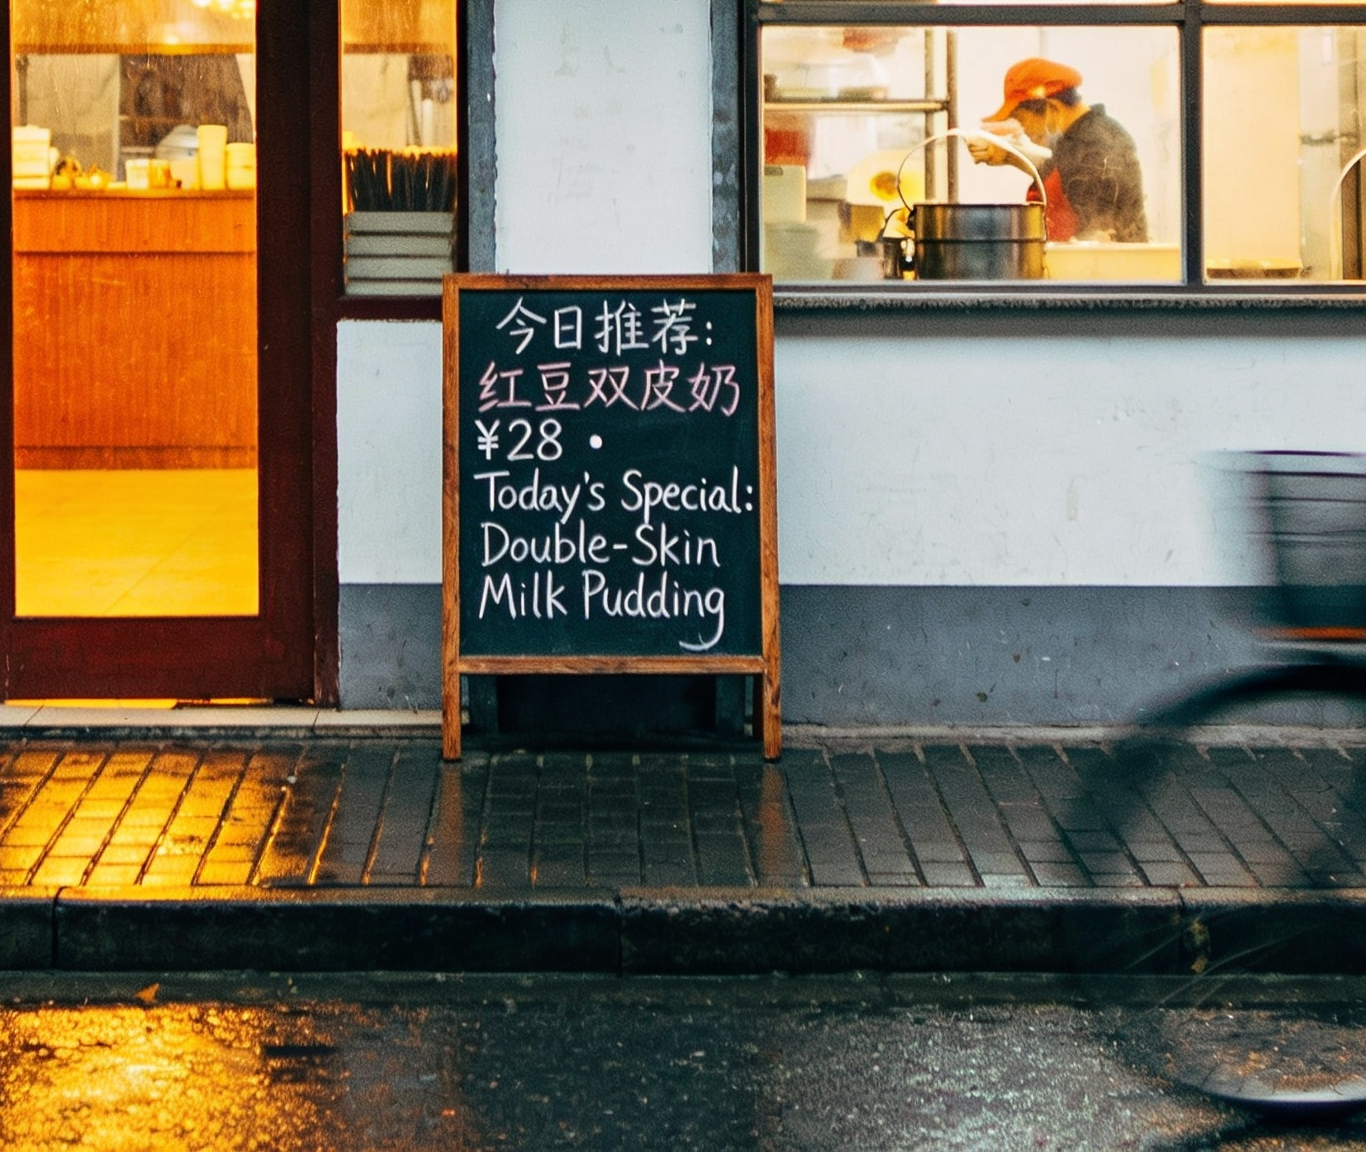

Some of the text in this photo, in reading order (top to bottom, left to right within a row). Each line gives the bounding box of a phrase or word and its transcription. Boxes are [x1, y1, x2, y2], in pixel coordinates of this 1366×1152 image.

[496, 297, 713, 356] 今日推荐:
[479, 359, 741, 417] 红豆双皮奶
[475, 418, 564, 461] ¥28
[473, 465, 753, 524] Today's Special:
[481, 520, 721, 568] Double-Skin
[479, 569, 725, 651] Milk Pudding
